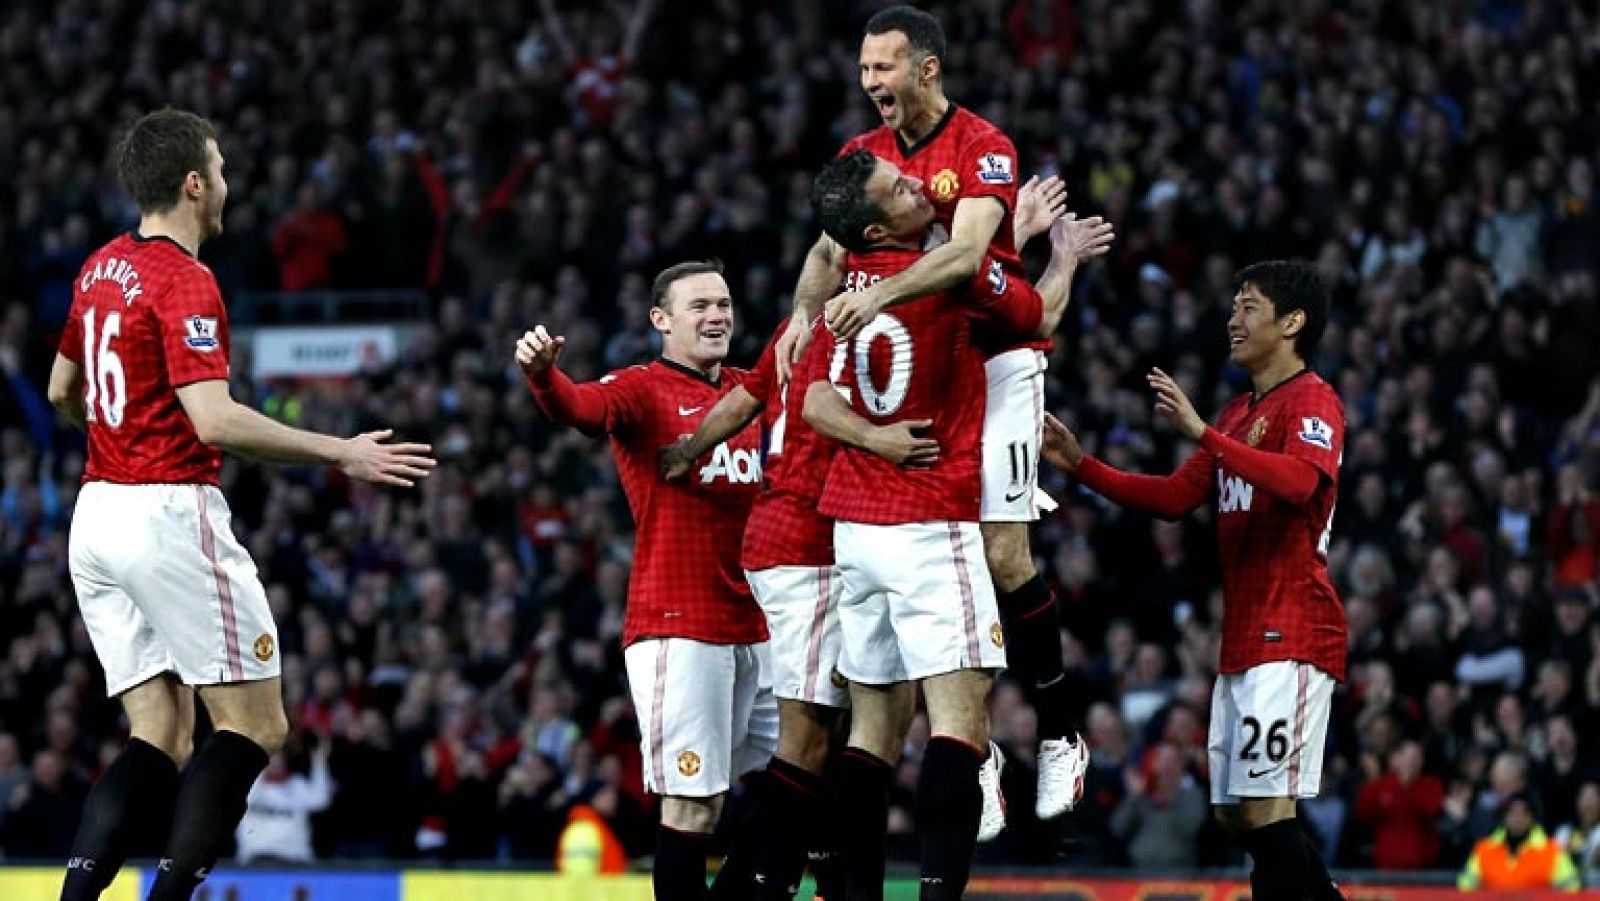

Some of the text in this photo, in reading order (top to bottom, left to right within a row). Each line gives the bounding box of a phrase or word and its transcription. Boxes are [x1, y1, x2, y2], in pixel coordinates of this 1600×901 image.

[81, 257, 142, 307] CARRICK
[83, 306, 125, 428] 16
[1007, 441, 1028, 485] 11
[1239, 714, 1288, 763] 26
